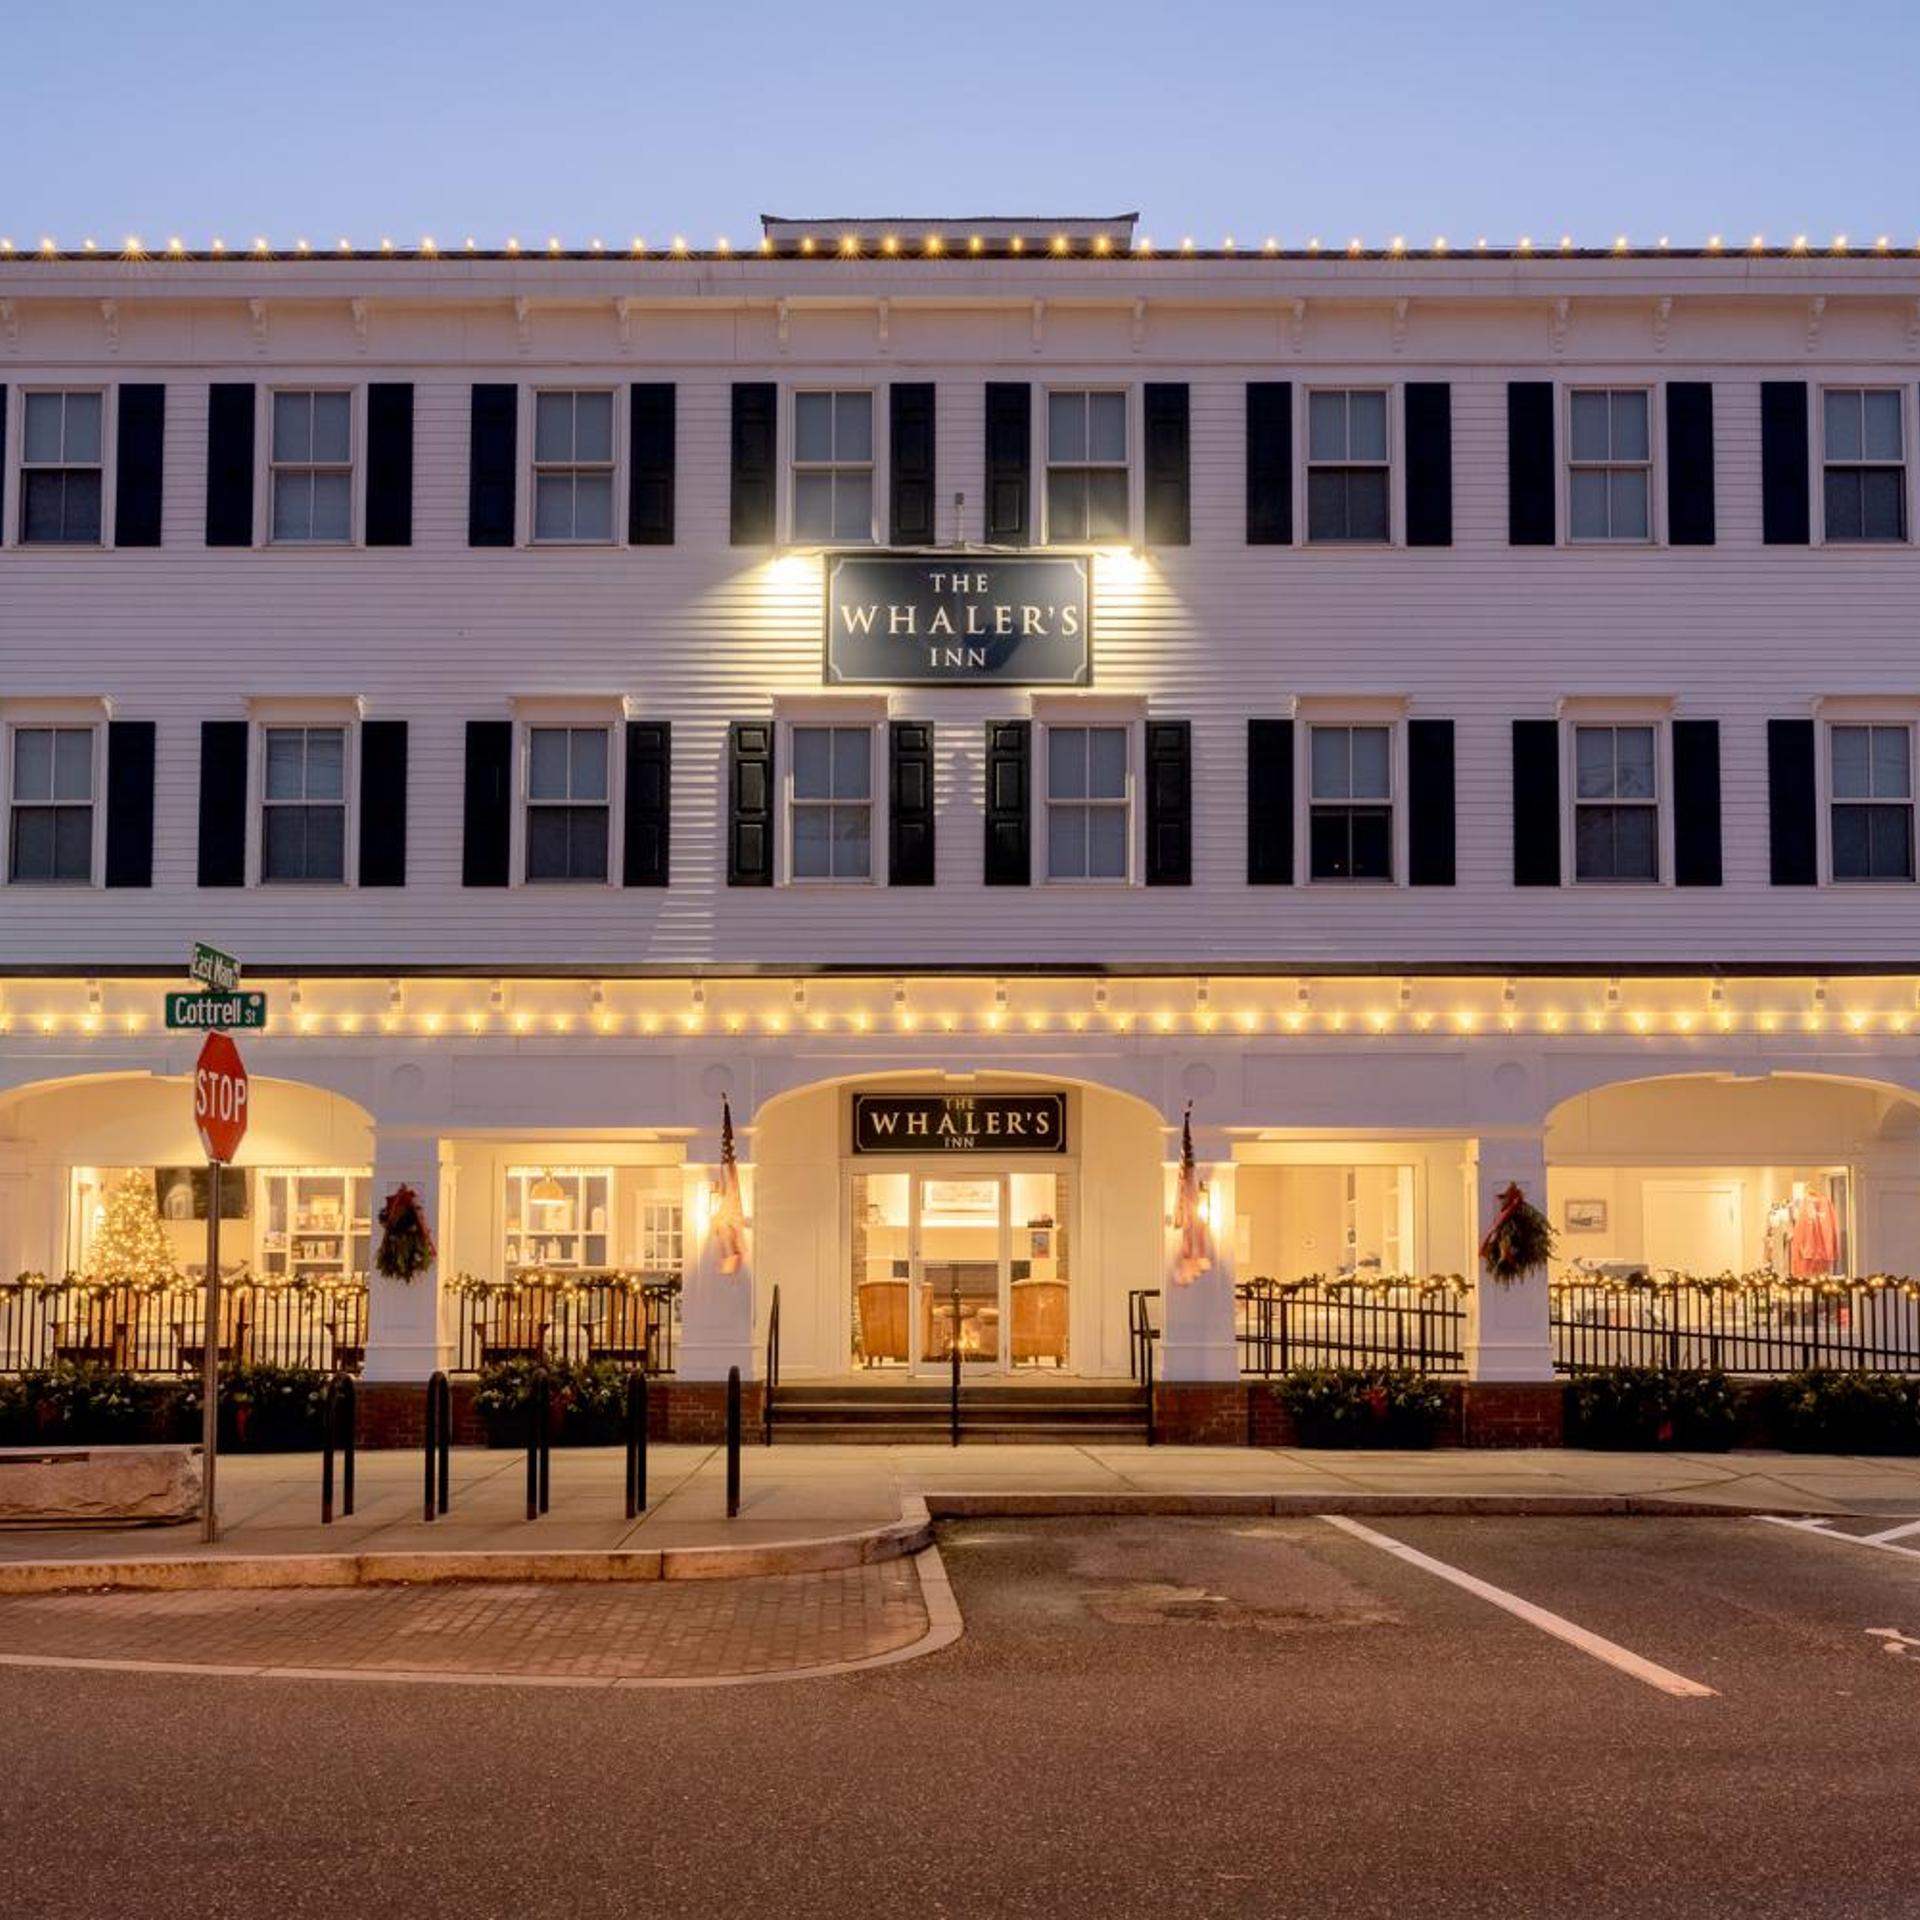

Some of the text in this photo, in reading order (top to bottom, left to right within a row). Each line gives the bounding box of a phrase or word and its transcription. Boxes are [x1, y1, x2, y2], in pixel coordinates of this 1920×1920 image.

[930, 573, 988, 593] THE
[841, 605, 1079, 635] WHALER'S
[930, 647, 986, 667] INN
[175, 997, 257, 1024] Cottrell St
[196, 1068, 246, 1123] STOP
[943, 1098, 976, 1110] THE
[870, 1112, 1050, 1135] WHALER'S
[944, 1136, 975, 1148] INN
